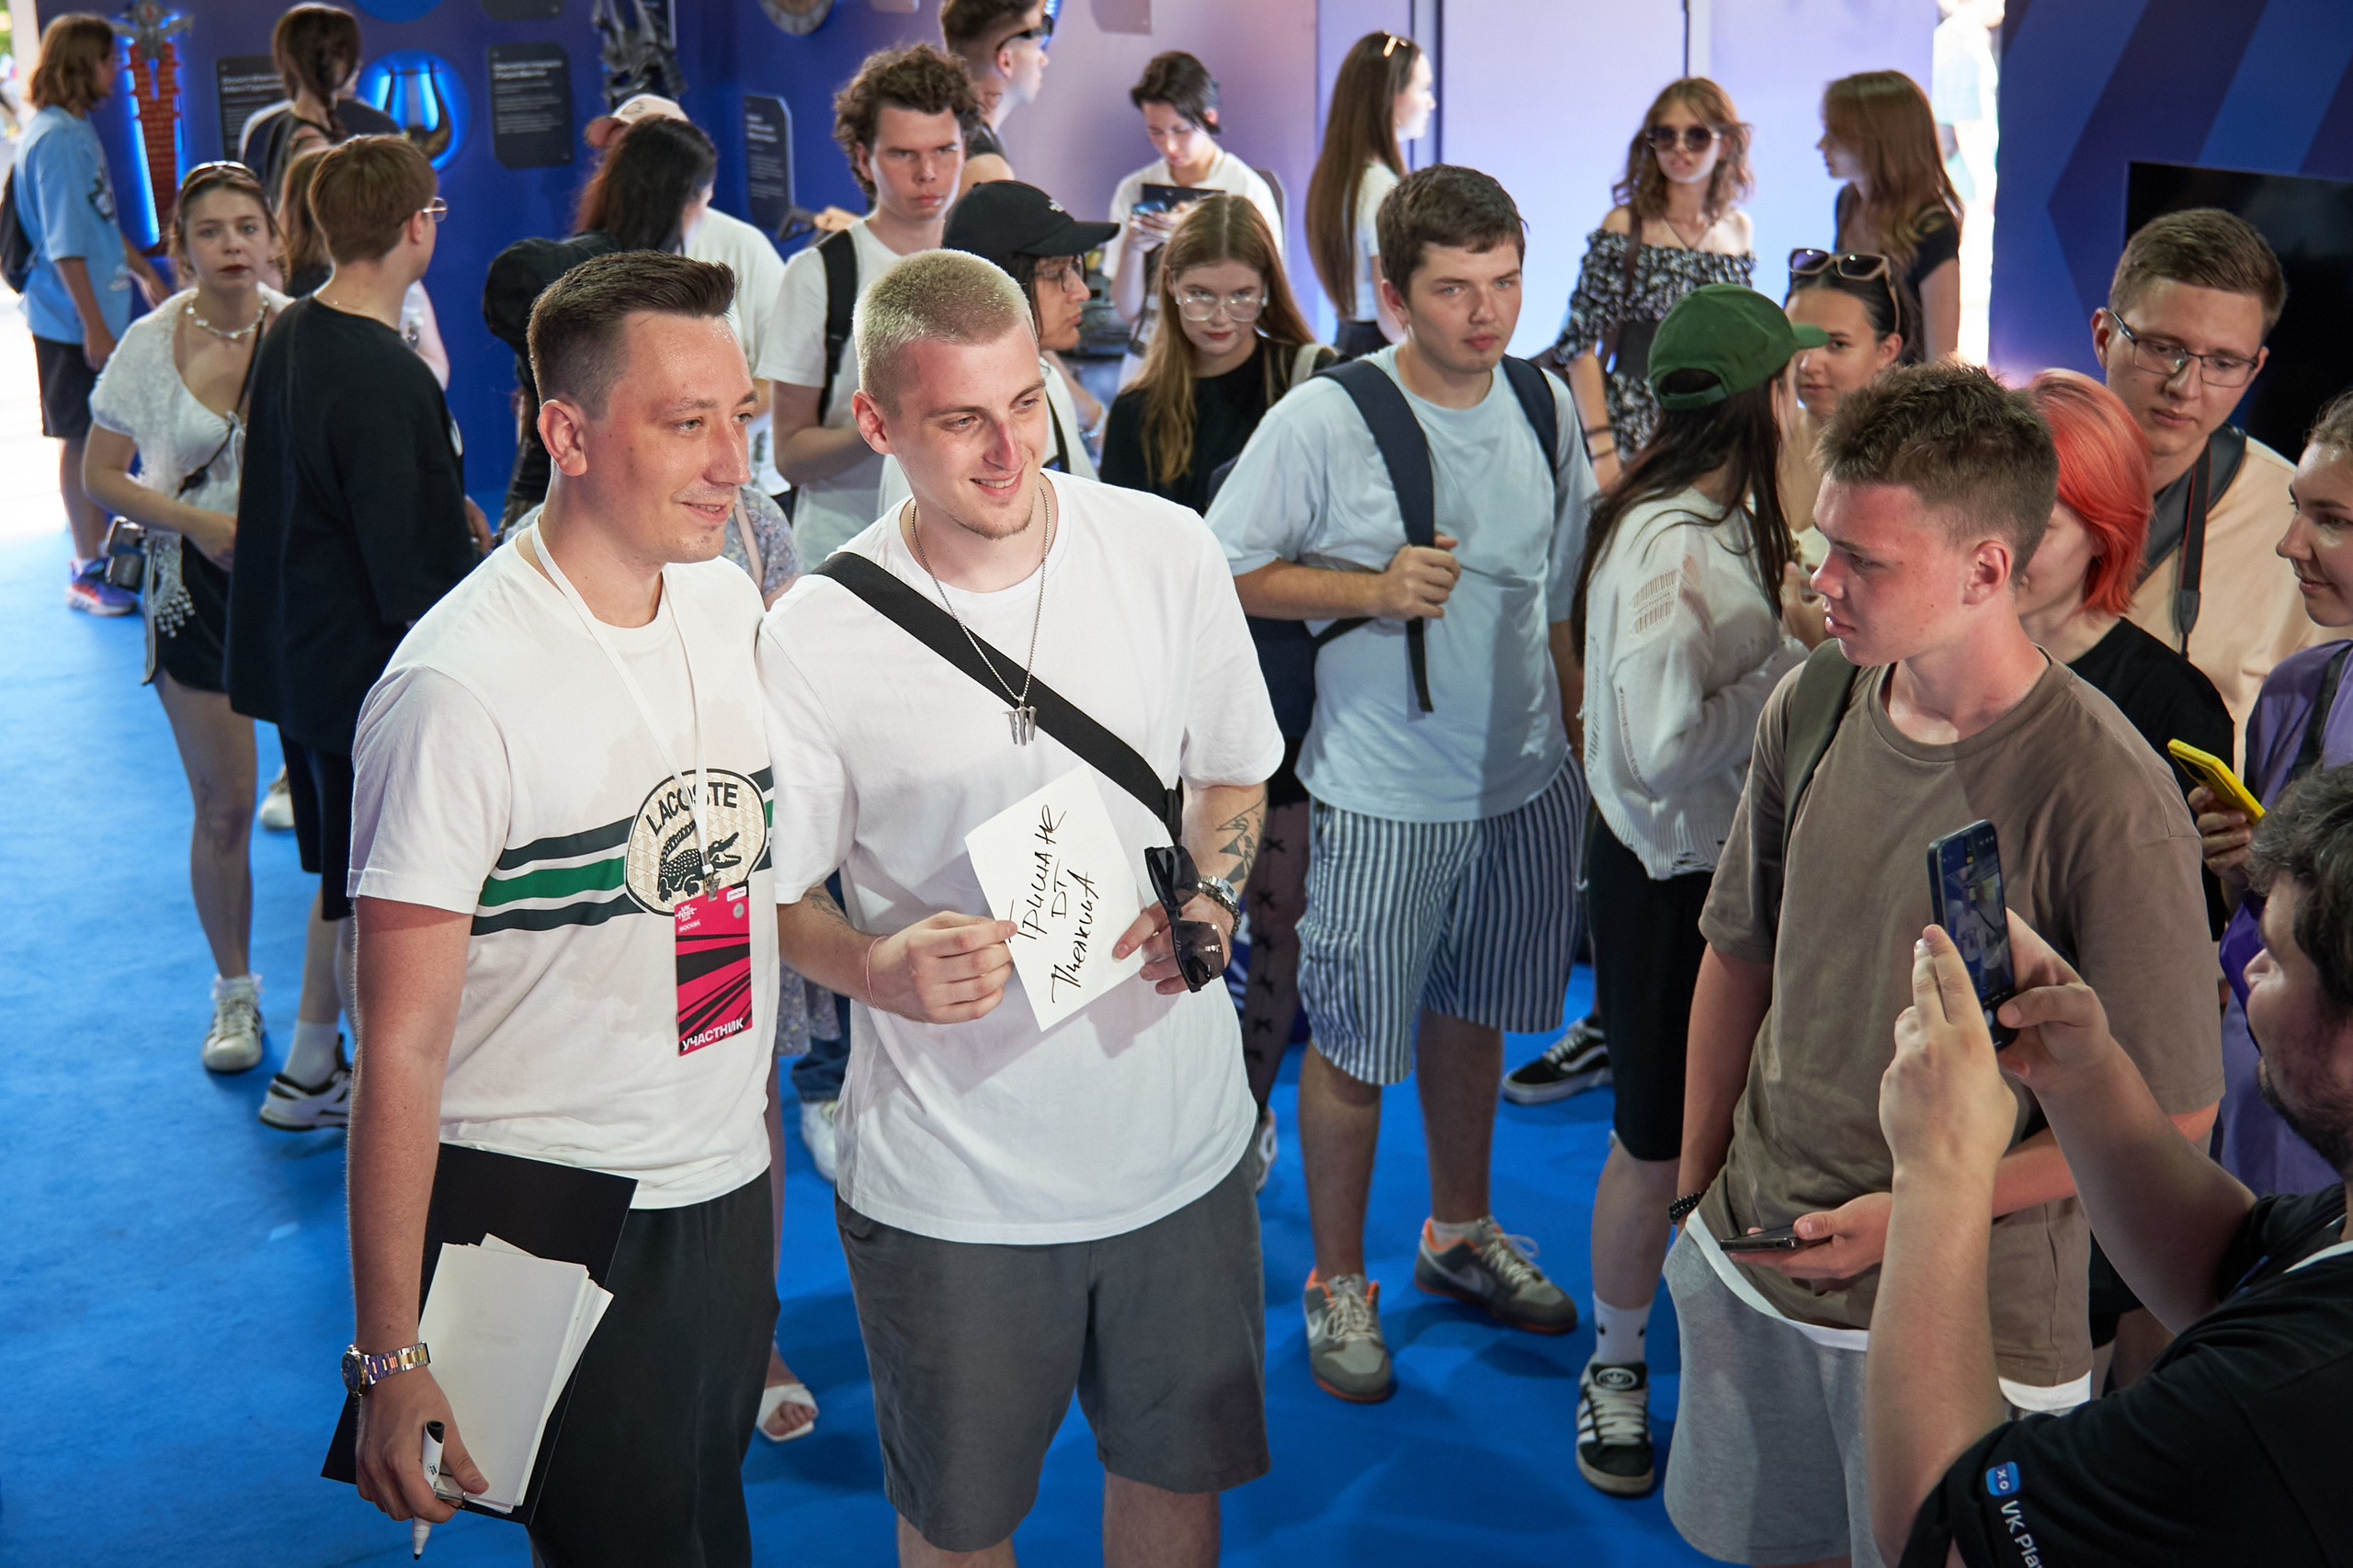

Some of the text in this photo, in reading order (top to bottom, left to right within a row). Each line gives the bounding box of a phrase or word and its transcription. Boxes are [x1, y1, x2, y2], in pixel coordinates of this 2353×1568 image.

[682, 1017, 744, 1051] УЧАСТНИК
[2000, 1500, 2043, 1568] VK Pla
